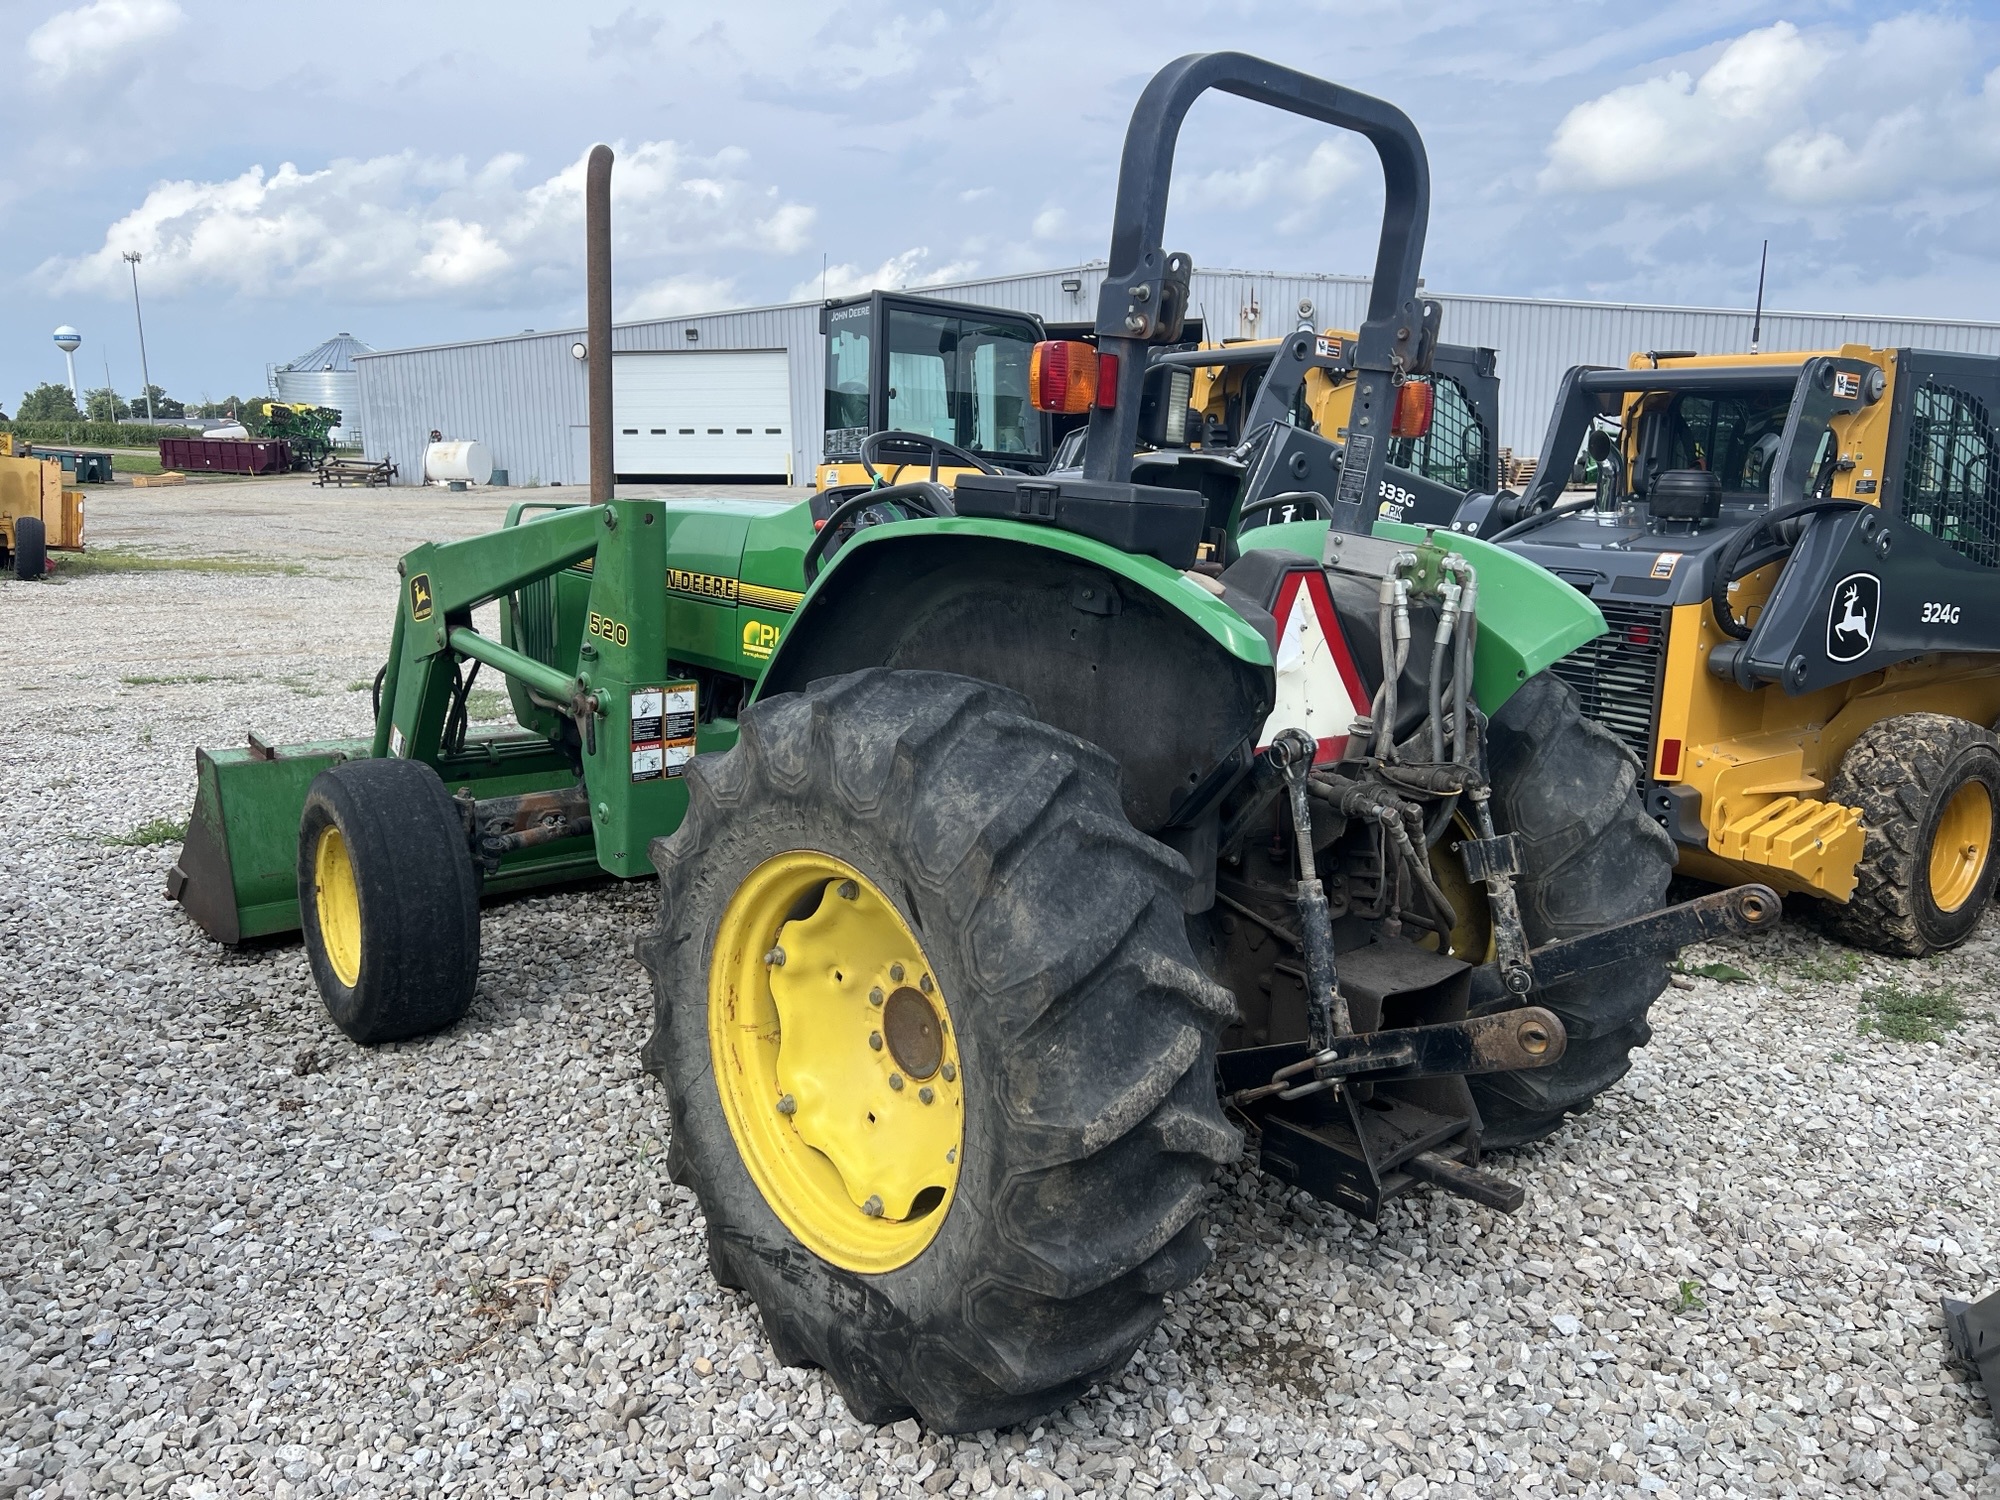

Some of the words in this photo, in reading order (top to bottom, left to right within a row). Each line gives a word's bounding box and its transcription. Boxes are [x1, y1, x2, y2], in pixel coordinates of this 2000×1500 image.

[831, 310, 848, 322] JOHN
[848, 306, 870, 319] DEERE
[1378, 480, 1416, 508] 333G
[680, 570, 736, 599] DEERE
[1921, 602, 1961, 625] 324G
[589, 611, 629, 647] 520
